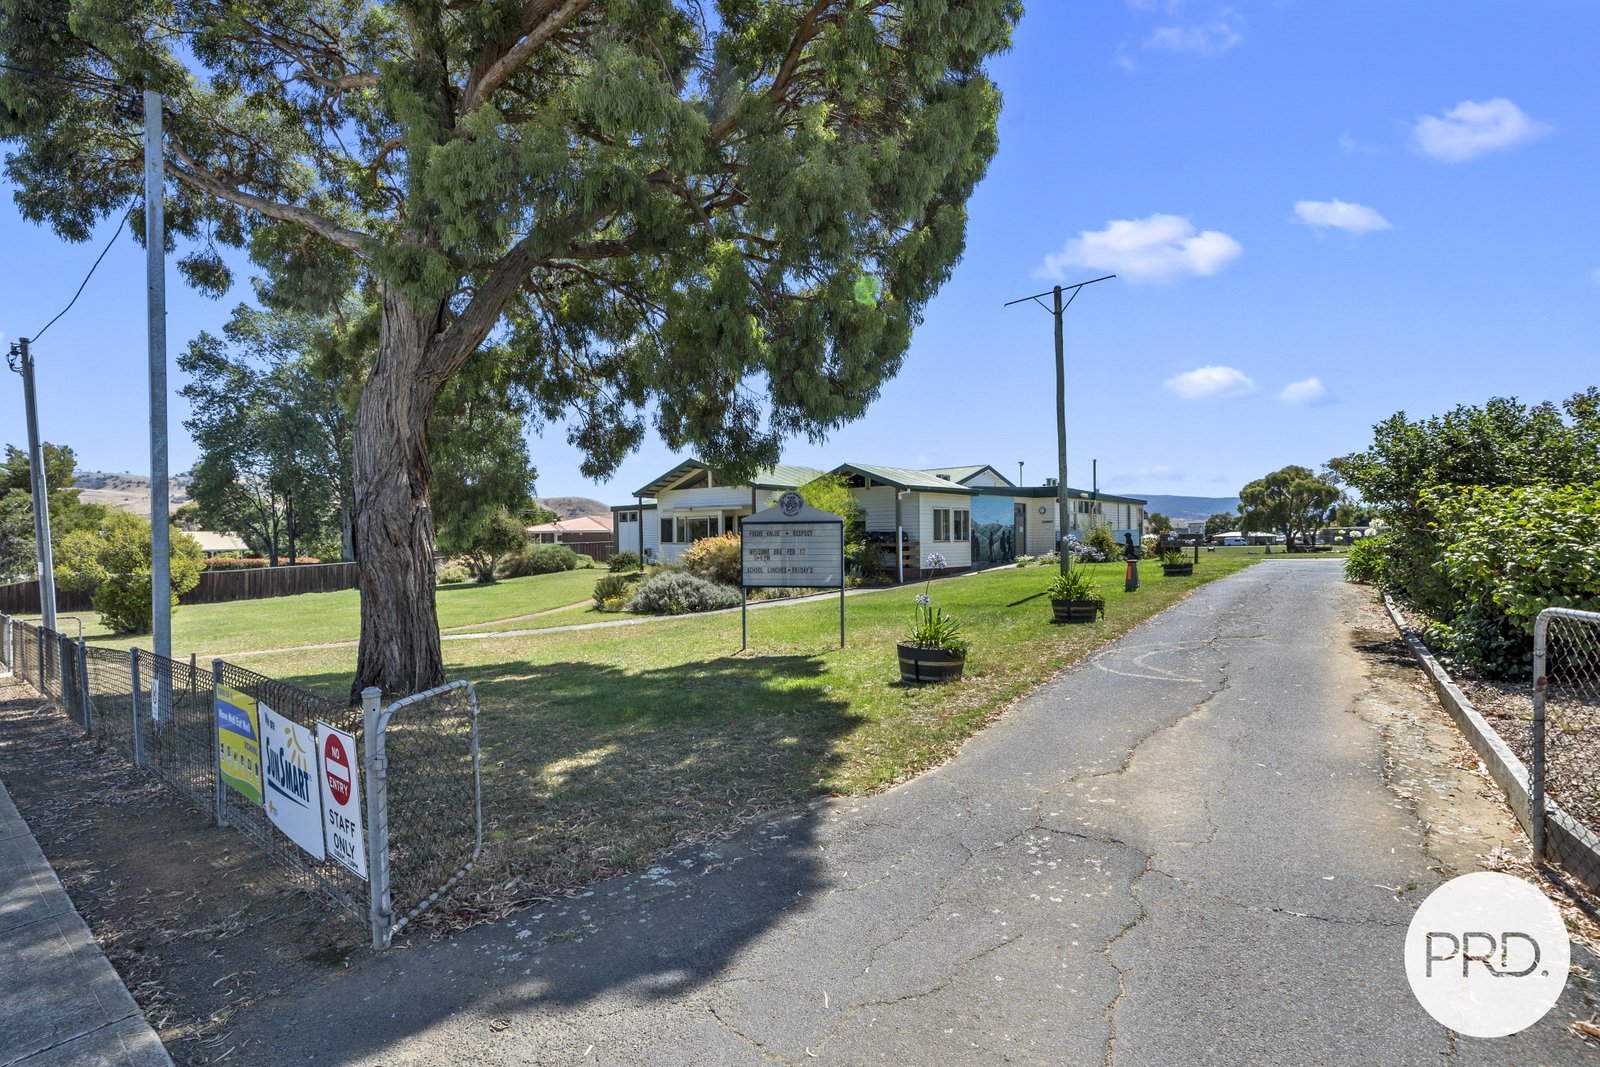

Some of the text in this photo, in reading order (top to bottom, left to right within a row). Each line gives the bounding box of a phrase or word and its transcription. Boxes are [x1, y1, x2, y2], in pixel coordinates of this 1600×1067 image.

[331, 745, 340, 760] NO
[329, 777, 349, 797] ENTRY
[329, 808, 356, 838] STAFF
[333, 832, 355, 860] ONLY
